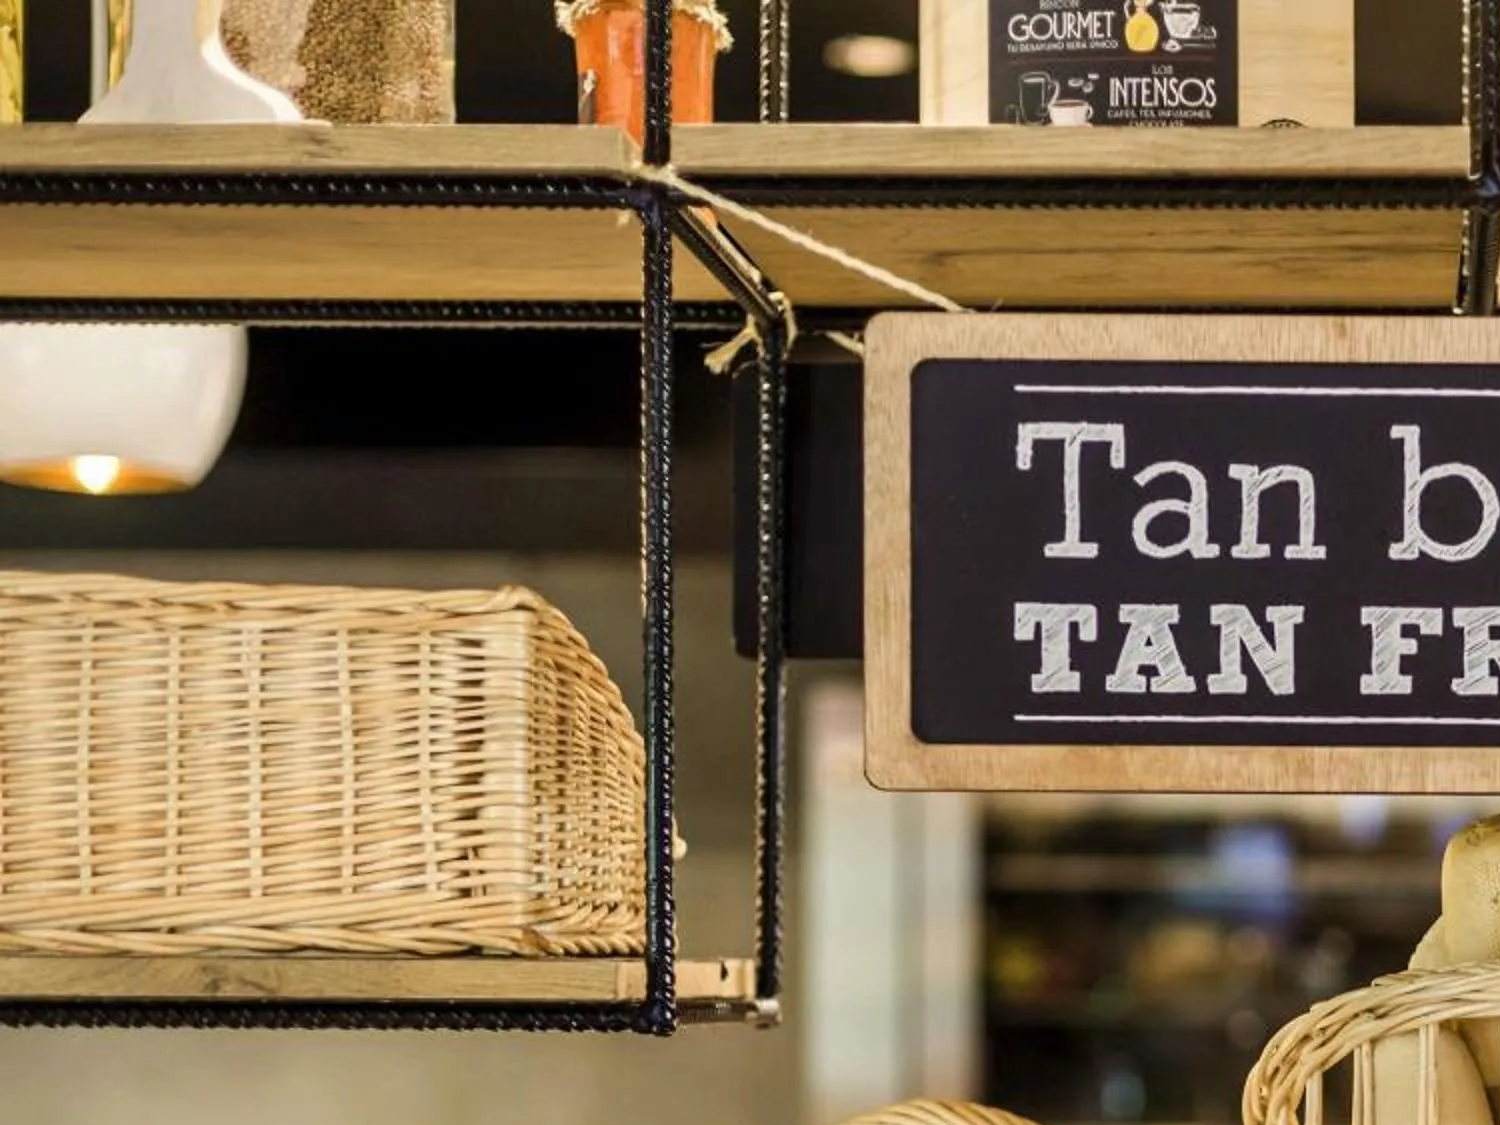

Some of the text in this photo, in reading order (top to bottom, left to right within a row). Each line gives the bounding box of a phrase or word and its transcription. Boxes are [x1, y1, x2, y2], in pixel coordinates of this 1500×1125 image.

[1007, 10, 1116, 41] GOURMET
[1109, 77, 1216, 107] INTENSOS
[1015, 421, 1327, 560] Tan
[1014, 602, 1305, 696] TAN
